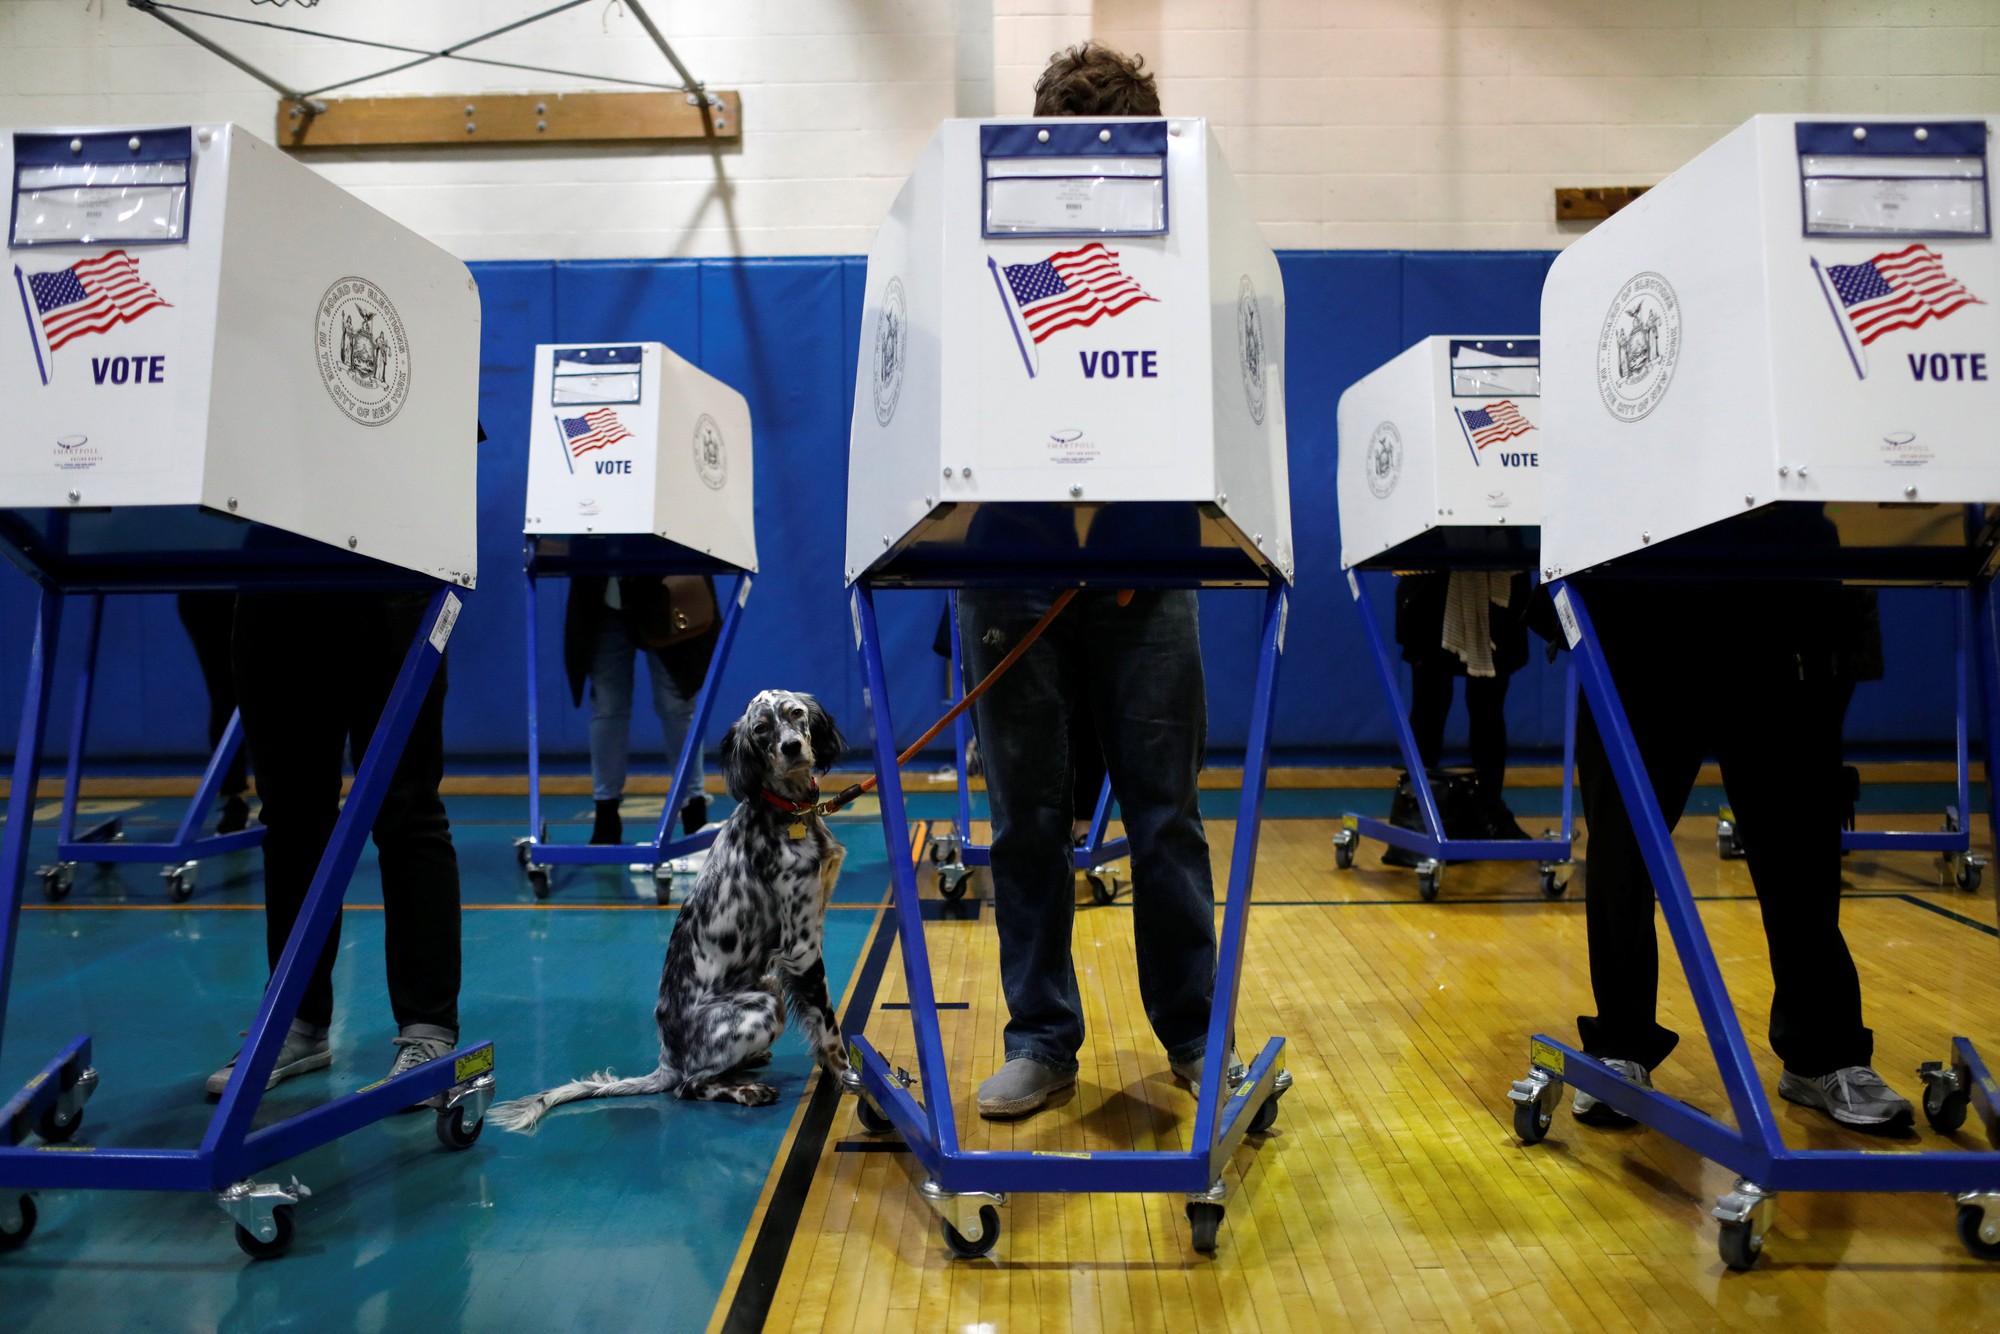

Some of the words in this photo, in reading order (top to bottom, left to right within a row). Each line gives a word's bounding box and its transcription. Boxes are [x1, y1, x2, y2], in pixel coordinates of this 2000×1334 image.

[323, 283, 351, 317] BOARD
[352, 283, 365, 295] OF
[367, 288, 405, 354] ELECTIONS
[320, 331, 327, 348] IN
[91, 355, 165, 386] VOTE
[321, 351, 335, 382] THE
[1080, 350, 1158, 379] VOTE
[1907, 352, 1988, 381] VOTE
[333, 384, 356, 411] CITY
[391, 370, 407, 404] YORK
[356, 407, 370, 418] OF
[371, 401, 392, 419] NEW
[595, 460, 632, 475] VOTE
[1500, 453, 1539, 468] VOTE
